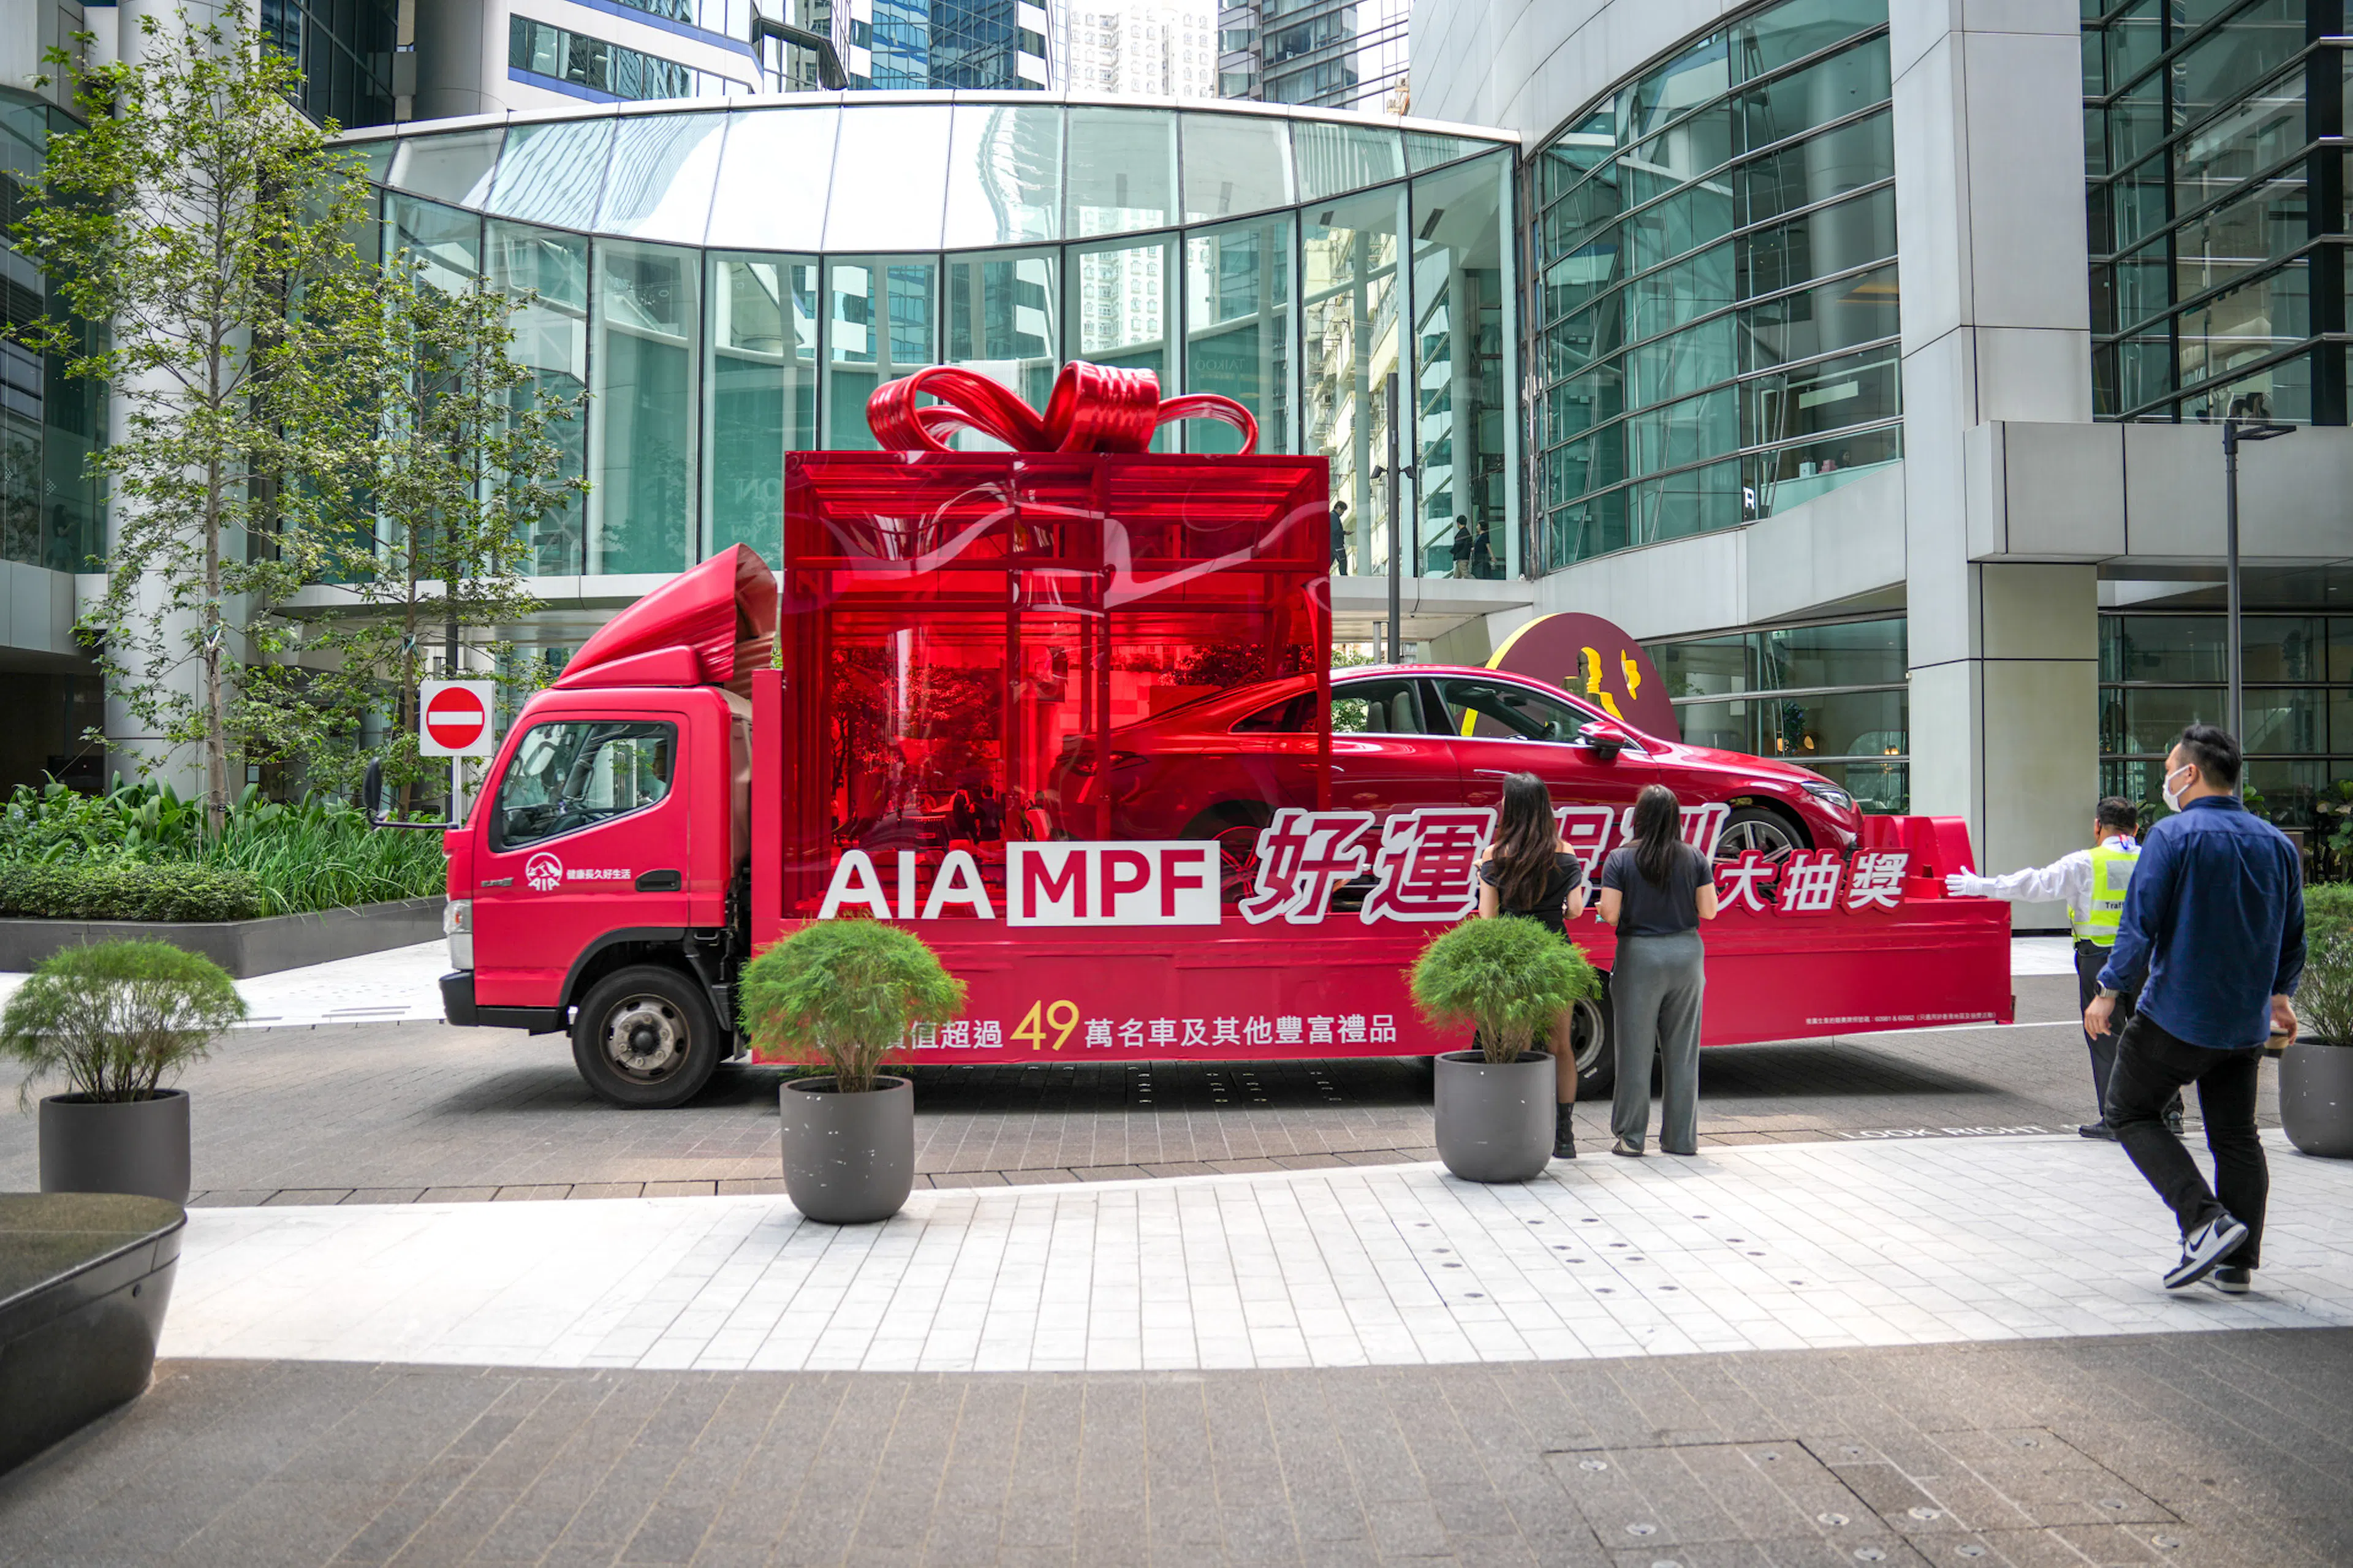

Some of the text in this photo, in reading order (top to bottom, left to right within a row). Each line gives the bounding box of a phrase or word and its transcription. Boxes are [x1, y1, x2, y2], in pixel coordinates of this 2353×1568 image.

[528, 877, 561, 892] AIA
[566, 869, 631, 880] 健康長久好生活
[818, 849, 1205, 920] AIA MPF
[1716, 852, 1910, 912] 大抽獎
[880, 999, 1397, 1051] 值超過 49 萬名車及其他豐富禮品
[1839, 1125, 2048, 1140] LOOK RIGHT
